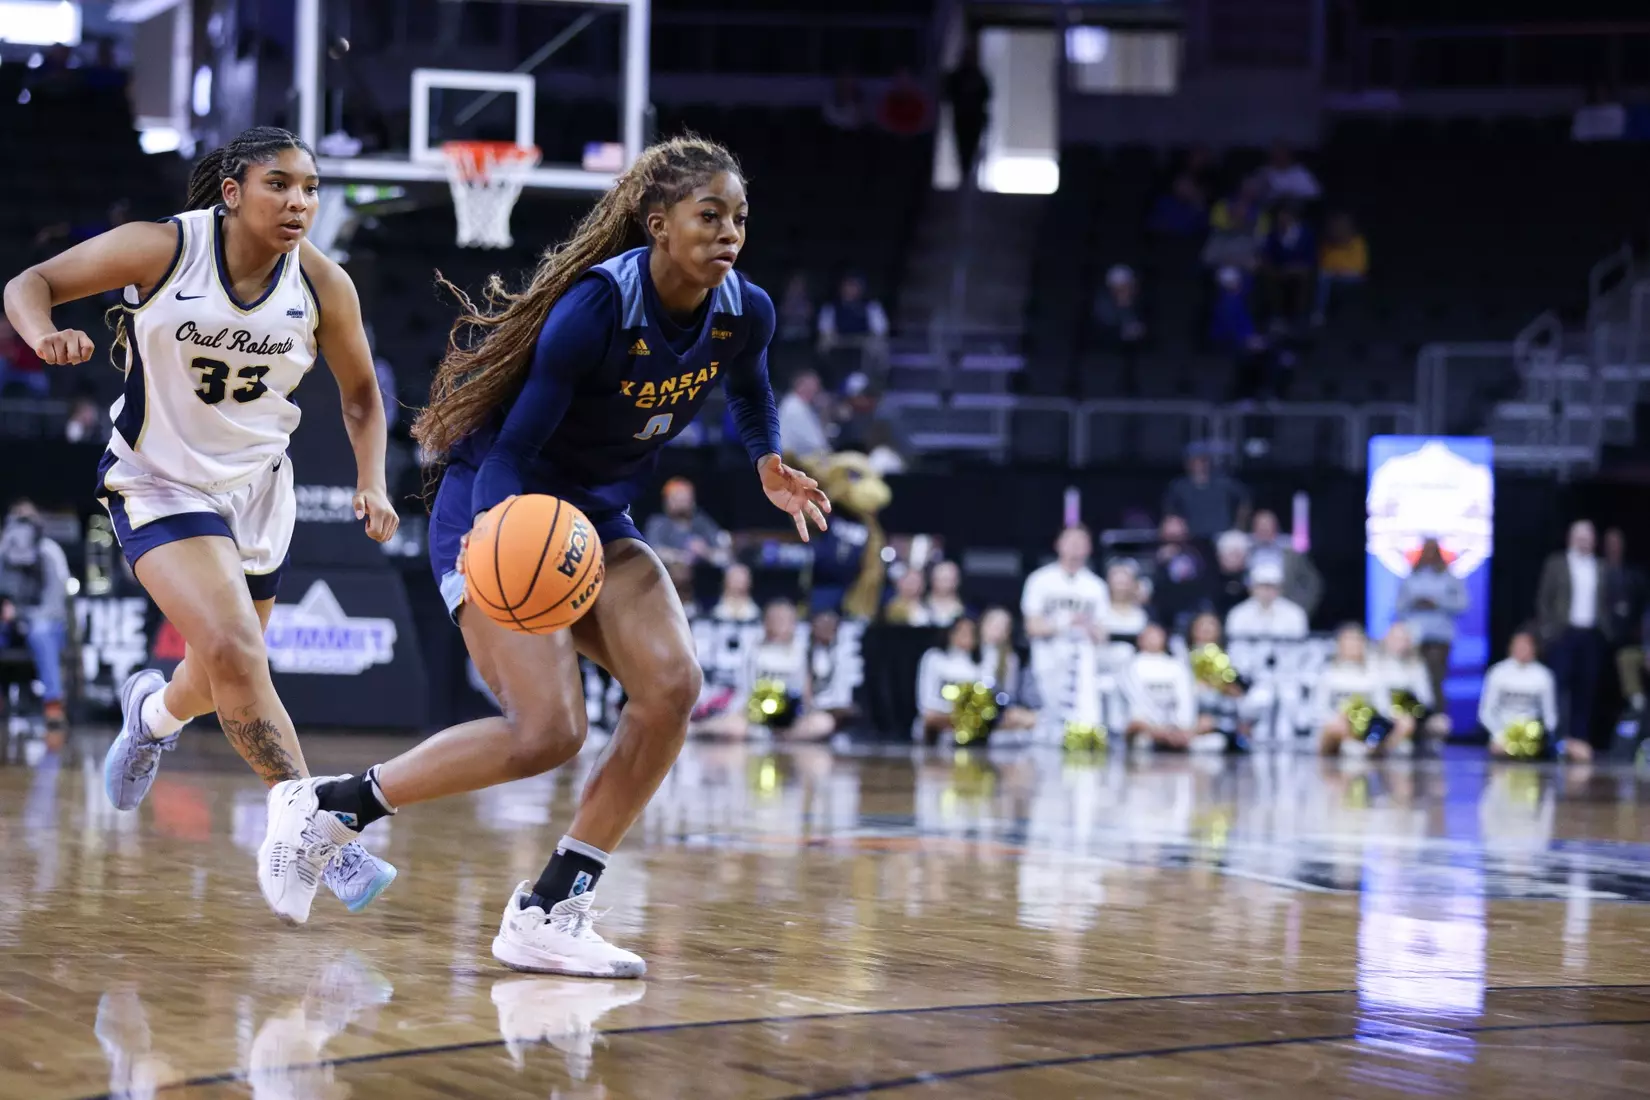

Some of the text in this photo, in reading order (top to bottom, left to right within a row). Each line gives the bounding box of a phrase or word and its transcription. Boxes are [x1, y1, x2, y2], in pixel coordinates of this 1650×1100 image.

[175, 320, 294, 355] Oral Roberts
[191, 356, 270, 405] 33
[635, 385, 701, 408] CITY
[557, 516, 589, 578] NCAA
[264, 626, 384, 650] UMMIT
